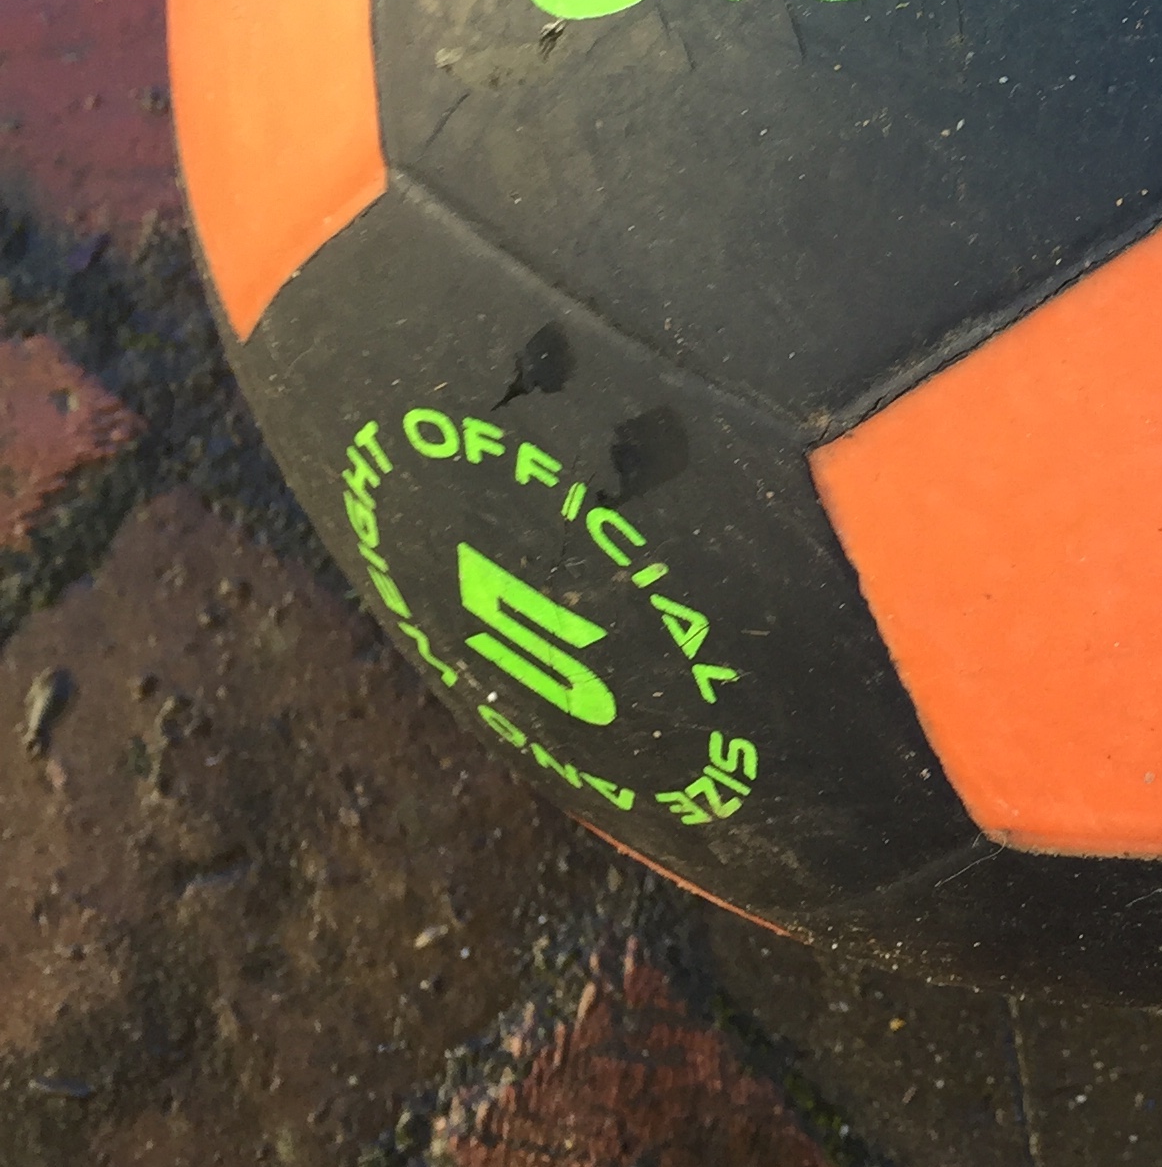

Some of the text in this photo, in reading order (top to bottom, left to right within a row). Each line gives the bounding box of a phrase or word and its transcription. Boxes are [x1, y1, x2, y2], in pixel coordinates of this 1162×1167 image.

[340, 419, 460, 689] WEIGHT
[402, 407, 741, 704] OFFICIAL
[456, 541, 618, 727] 5
[654, 730, 759, 826] SIZE
